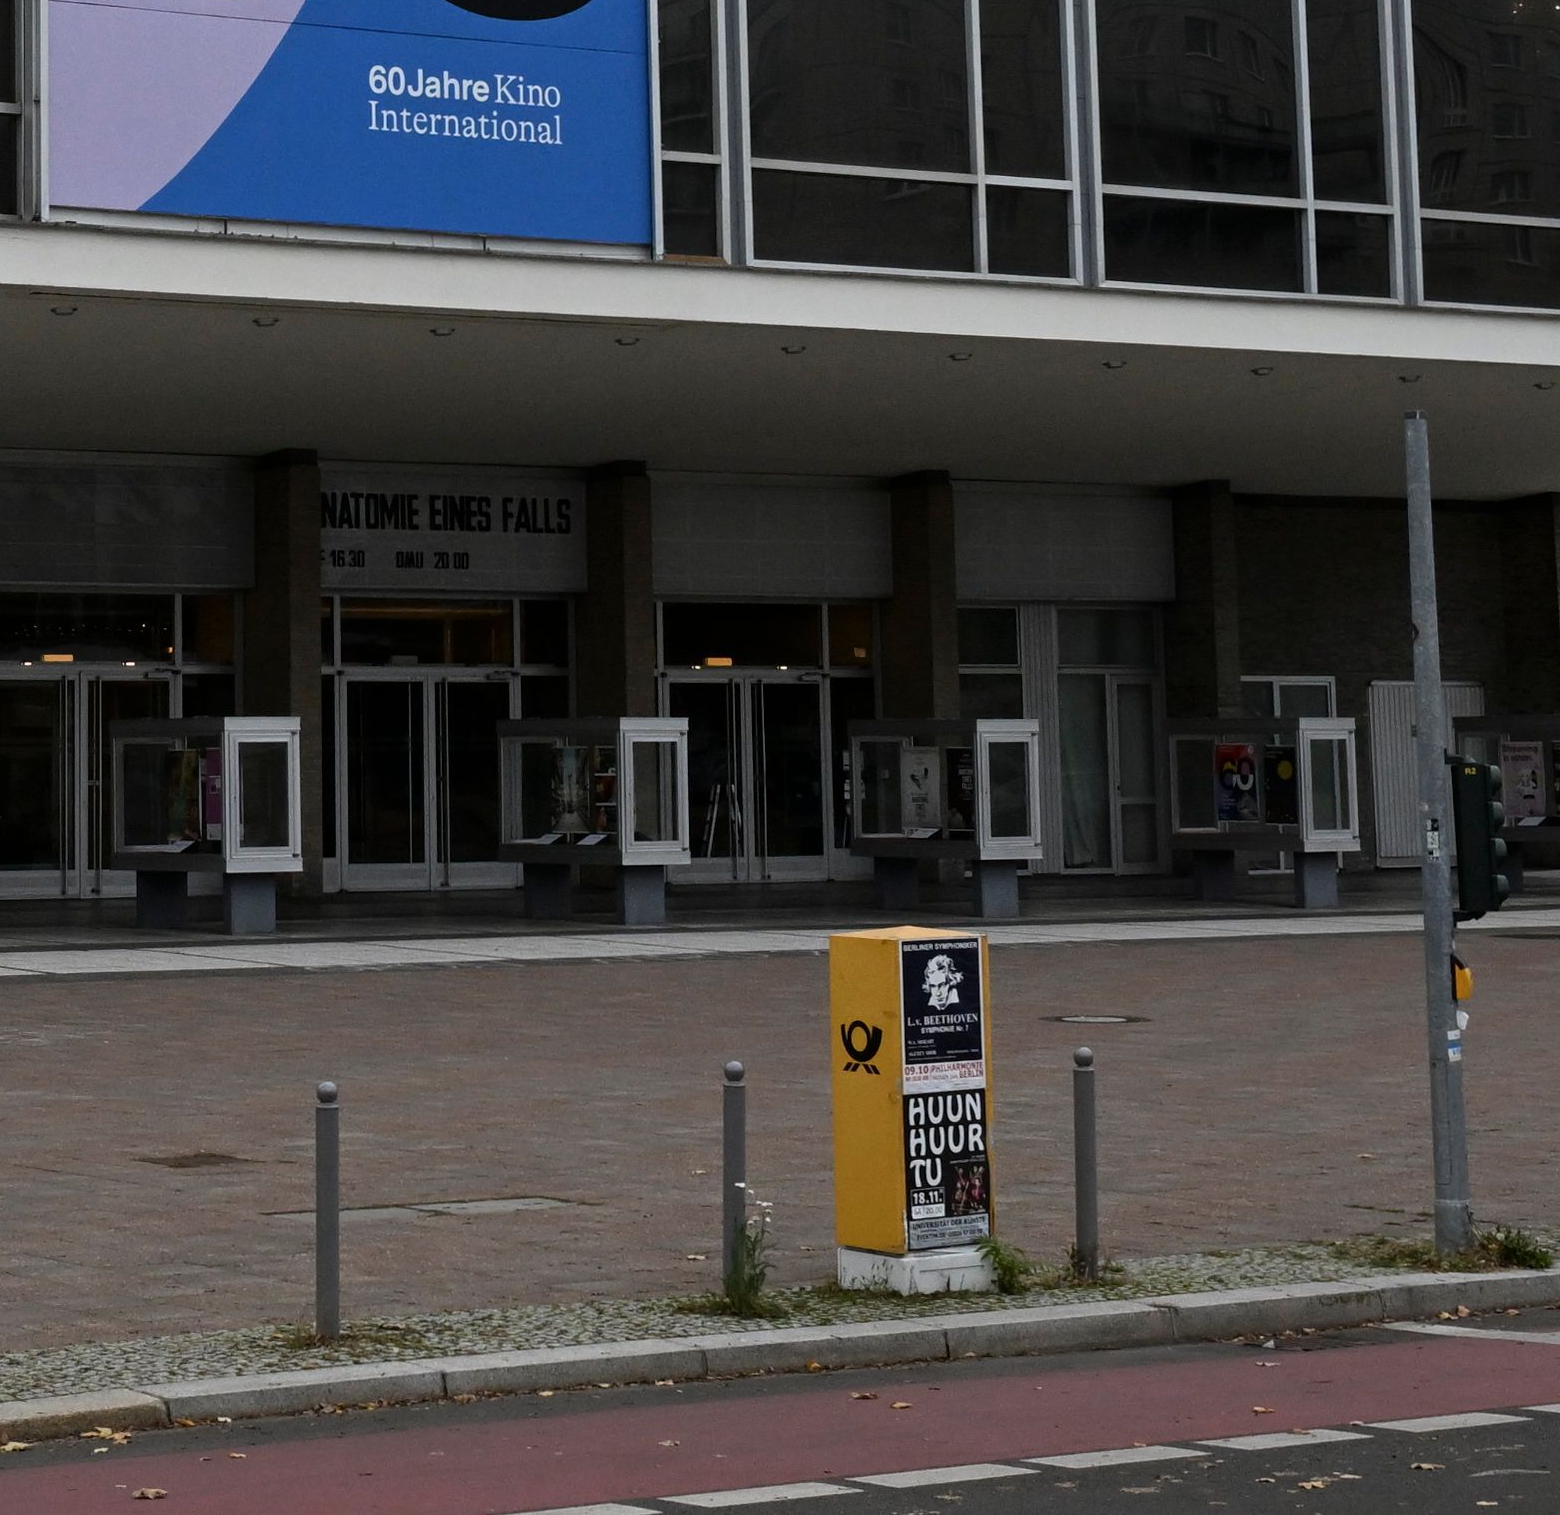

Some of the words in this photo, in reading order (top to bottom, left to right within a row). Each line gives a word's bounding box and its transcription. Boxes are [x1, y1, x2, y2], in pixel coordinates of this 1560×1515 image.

[367, 99, 564, 146] International
[428, 493, 492, 533] EINES
[502, 497, 572, 535] FALLS
[903, 943, 934, 952] BERLINER
[923, 1012, 979, 1026] BEETHOVEN
[904, 1065, 929, 1076] 09.10
[931, 1061, 983, 1072] PHILHARMONIE
[959, 1069, 984, 1079] BERLIN
[908, 1092, 982, 1127] HUUN
[909, 1123, 985, 1157] HUUR
[909, 1157, 943, 1188] TU
[913, 1190, 943, 1205] 18.11.
